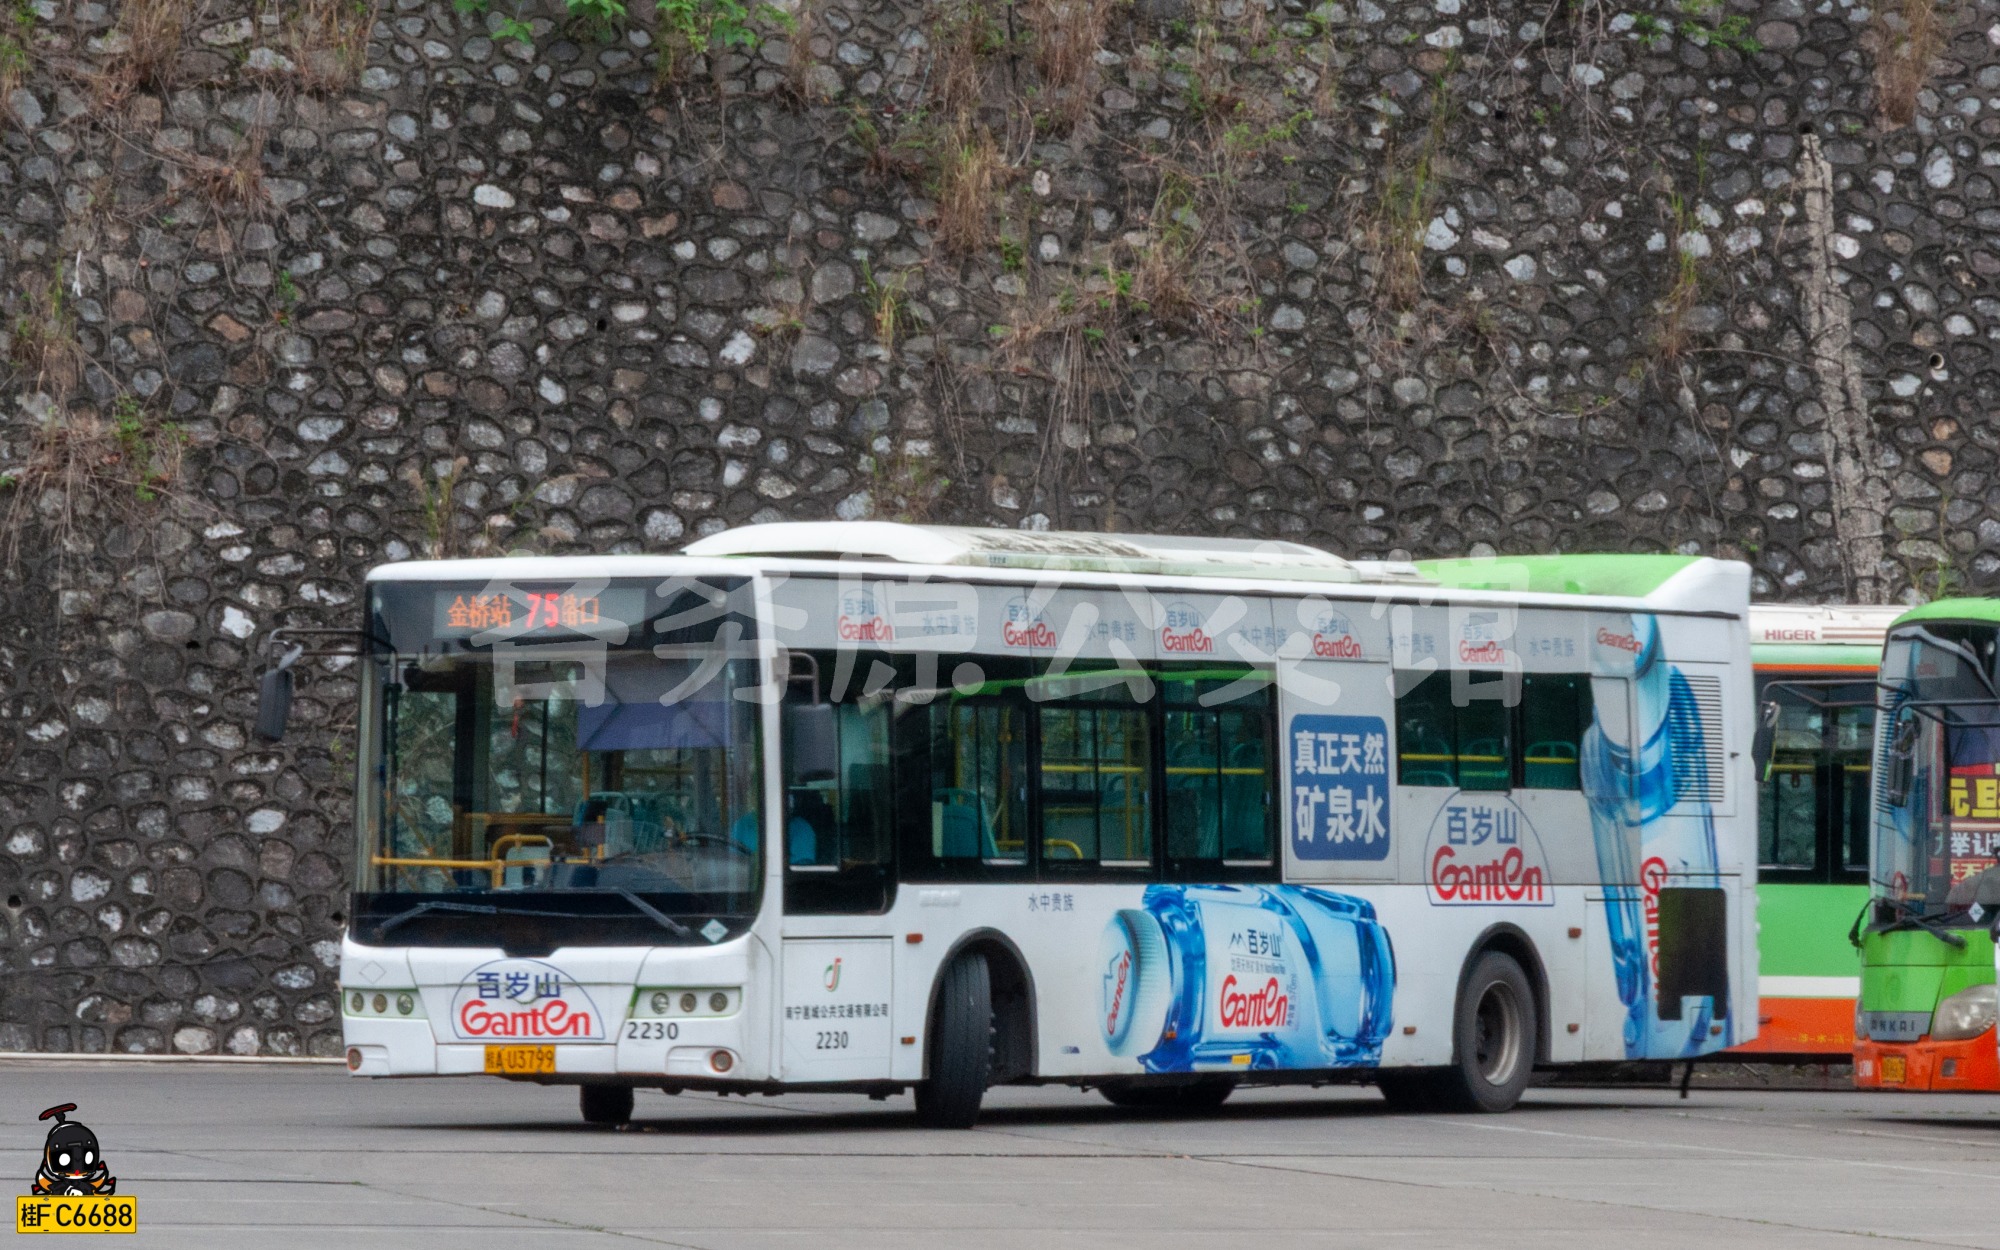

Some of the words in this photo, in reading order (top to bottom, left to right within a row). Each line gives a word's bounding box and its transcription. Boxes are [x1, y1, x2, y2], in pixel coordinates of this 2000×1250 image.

[448, 594, 511, 628] 金桥站
[525, 592, 559, 629] 75
[1168, 611, 1199, 628] 百岁山
[1764, 628, 1816, 641] HIGER
[1294, 730, 1386, 776] 真正天然
[1295, 784, 1386, 845] 矿泉水
[1950, 777, 2000, 819] 元旦
[1447, 806, 1518, 846] 百岁山
[1432, 845, 1543, 902] Ganten
[1028, 893, 1075, 912] 水中贵族
[1247, 928, 1281, 958] 百岁山
[477, 971, 562, 999] 百岁山
[1220, 974, 1288, 1028] Ganten
[460, 999, 592, 1037] Ganten
[627, 1022, 679, 1040] 2230
[816, 1031, 849, 1050] 2230
